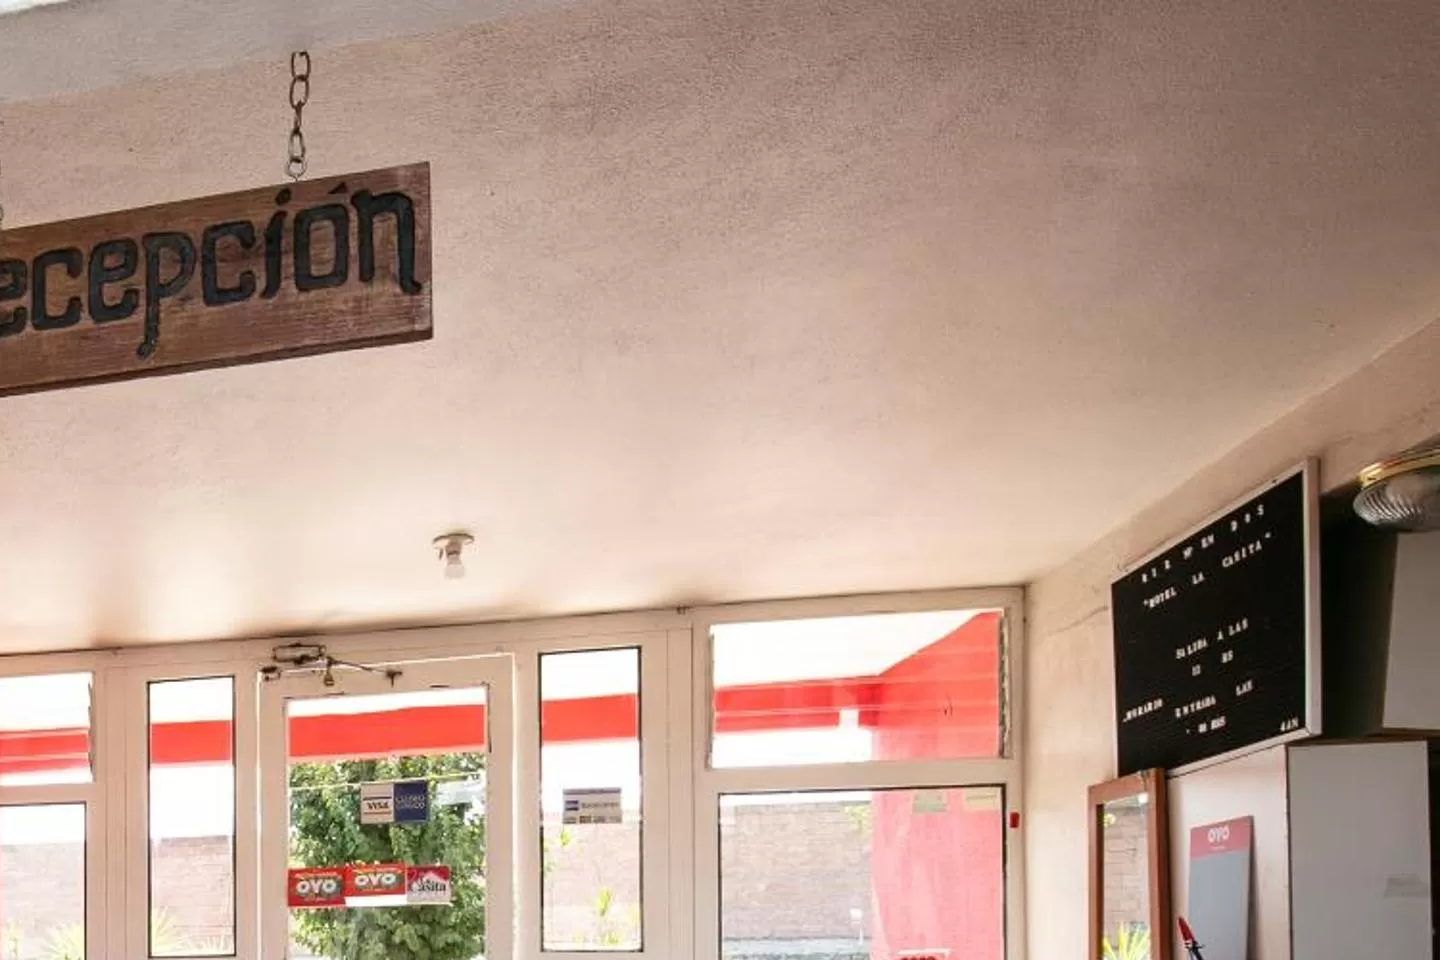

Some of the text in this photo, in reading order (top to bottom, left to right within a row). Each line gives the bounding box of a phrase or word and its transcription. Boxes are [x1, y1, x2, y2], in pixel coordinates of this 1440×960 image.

[1192, 572, 1205, 585] LA
[1208, 825, 1231, 844] OYO
[296, 878, 337, 894] OYO
[355, 873, 397, 887] OYO
